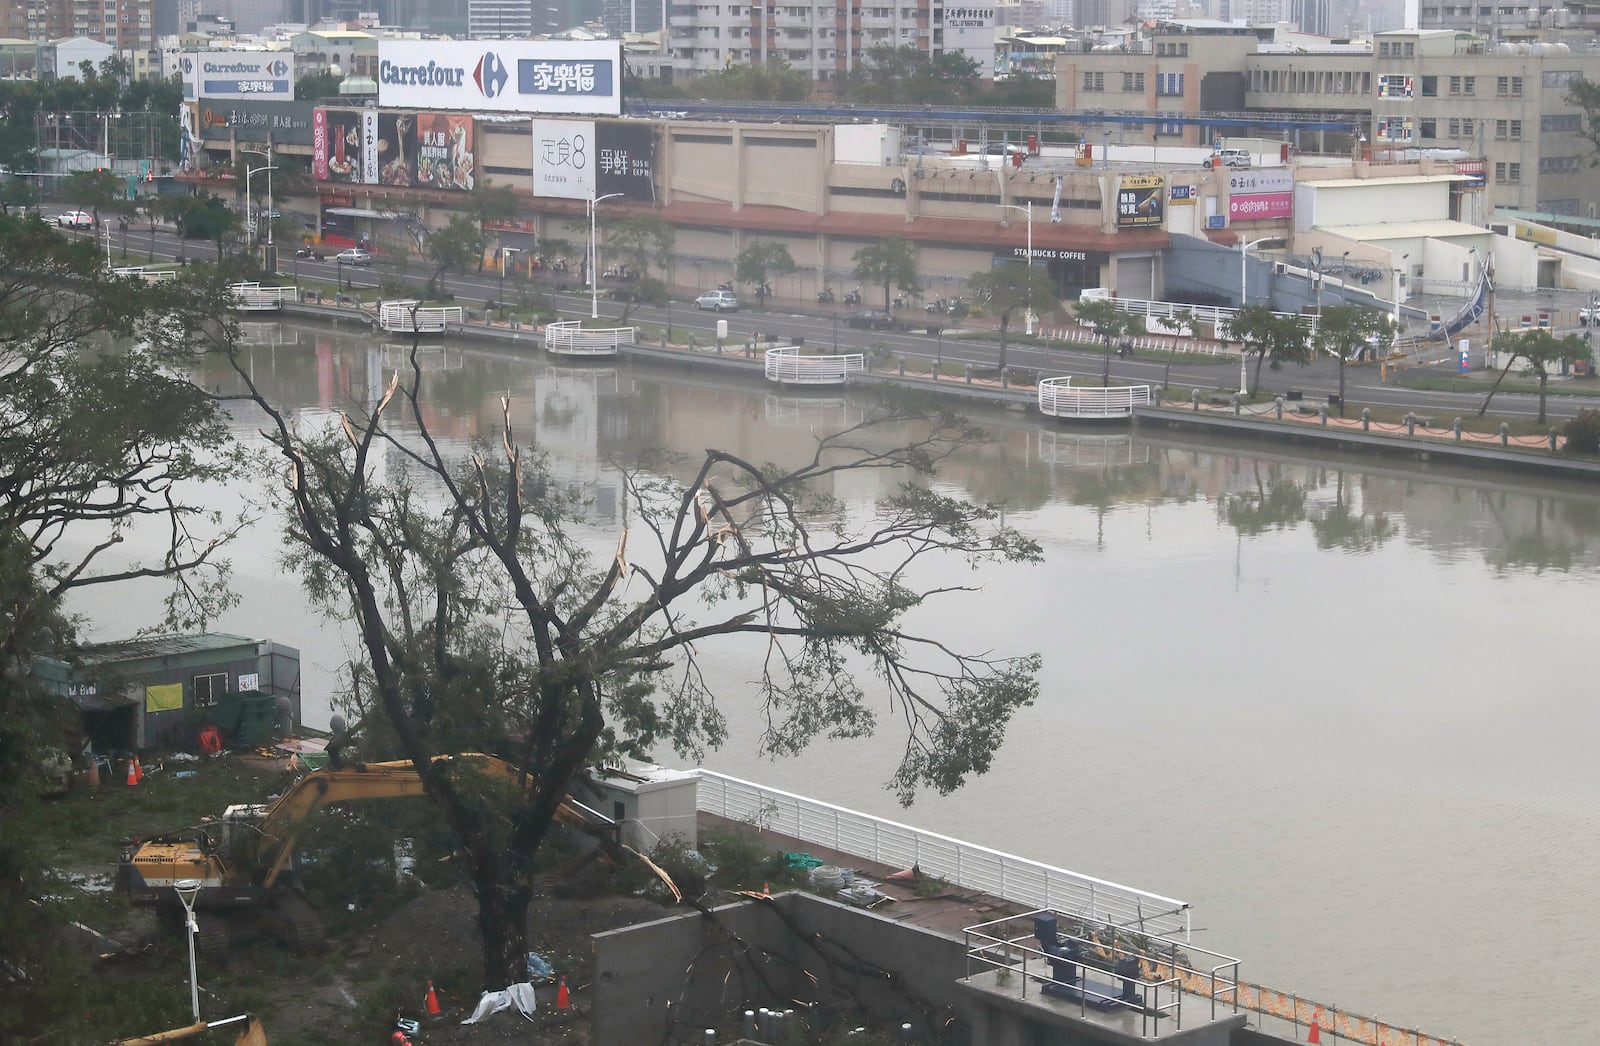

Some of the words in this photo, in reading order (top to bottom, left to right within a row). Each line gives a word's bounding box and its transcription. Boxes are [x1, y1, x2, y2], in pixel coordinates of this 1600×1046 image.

[203, 62, 260, 74] Carrefour
[379, 59, 465, 87] Carrefour
[533, 61, 595, 93] 家樂福
[237, 80, 274, 93] 家樂福
[541, 134, 586, 170] 定食8
[600, 149, 628, 175] 爭鮮
[1014, 248, 1057, 258] STARBUCKS
[1059, 251, 1086, 260] COFFEE
